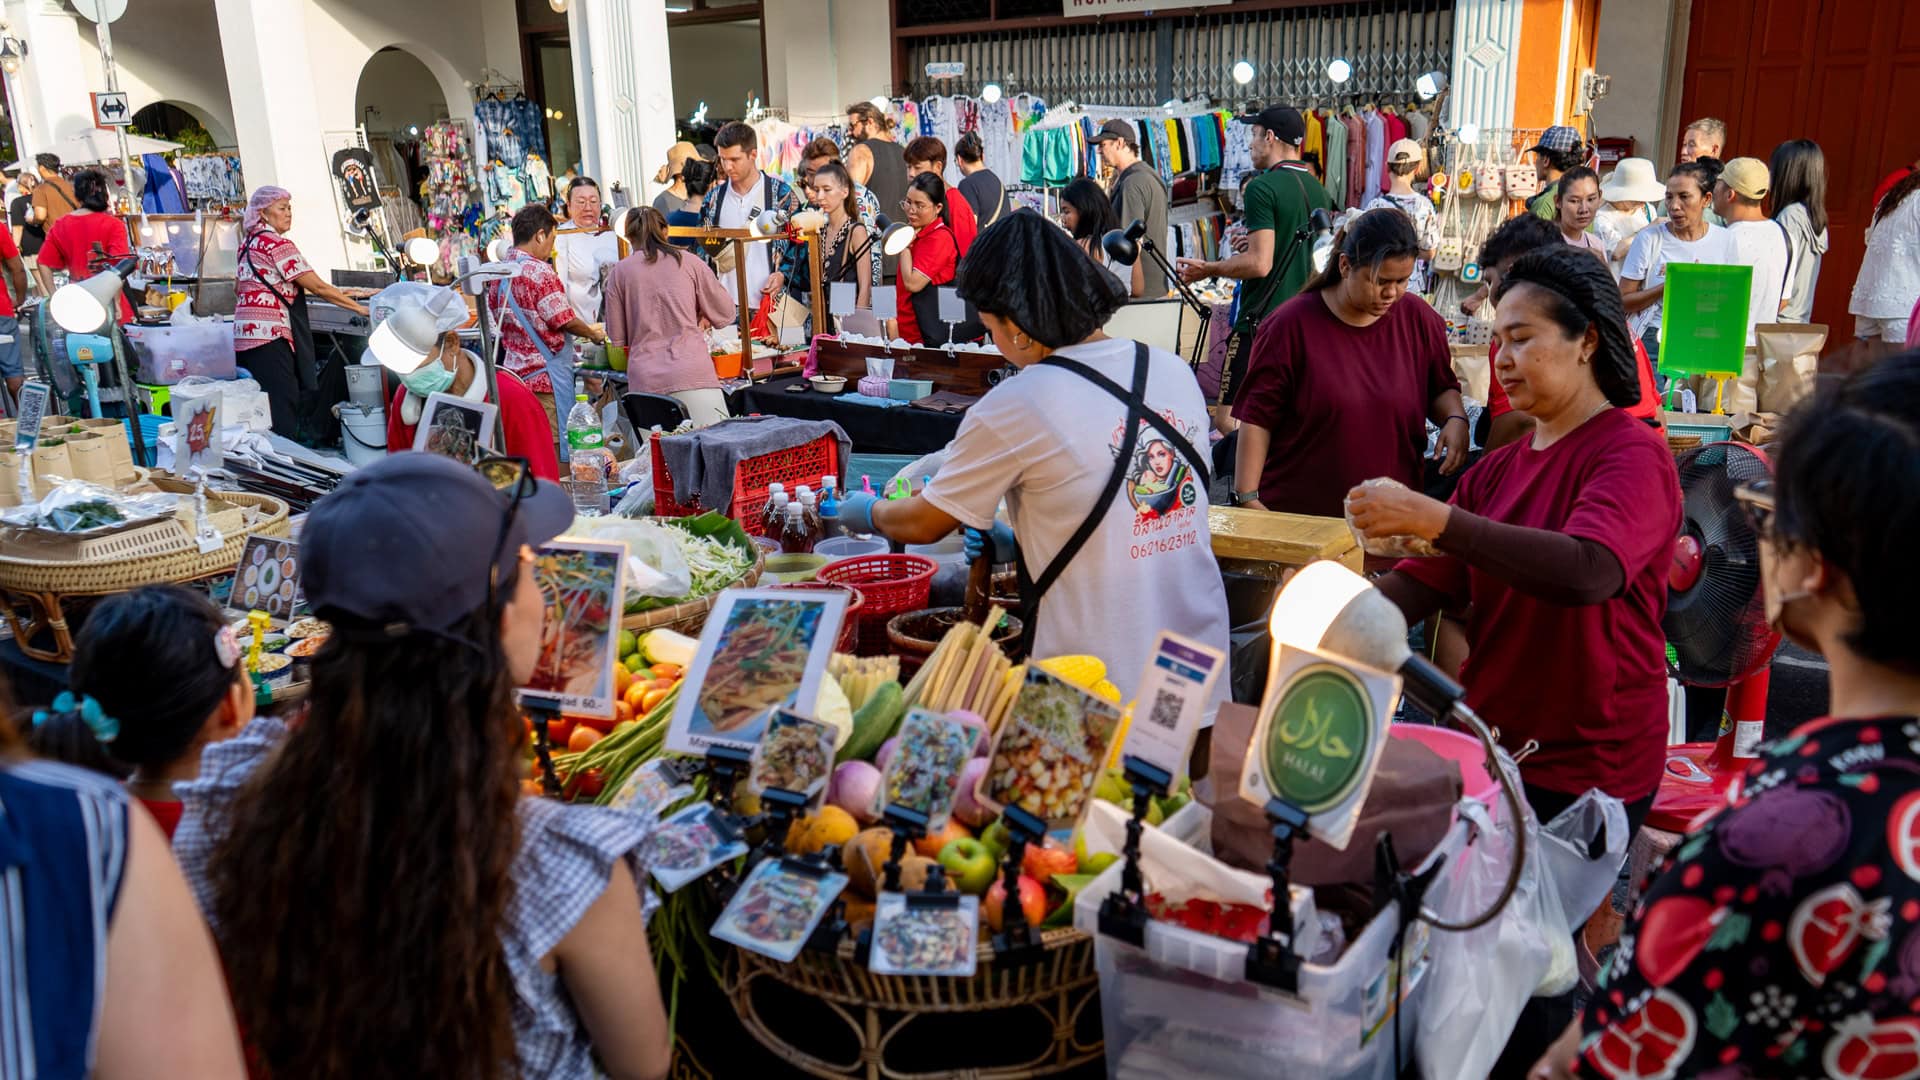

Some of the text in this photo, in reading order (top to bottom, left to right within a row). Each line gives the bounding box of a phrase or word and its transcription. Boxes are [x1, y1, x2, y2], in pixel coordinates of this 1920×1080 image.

[1130, 529, 1197, 560] 0621623112
[1280, 696, 1352, 759] حلال
[1282, 751, 1328, 783] HALAL
